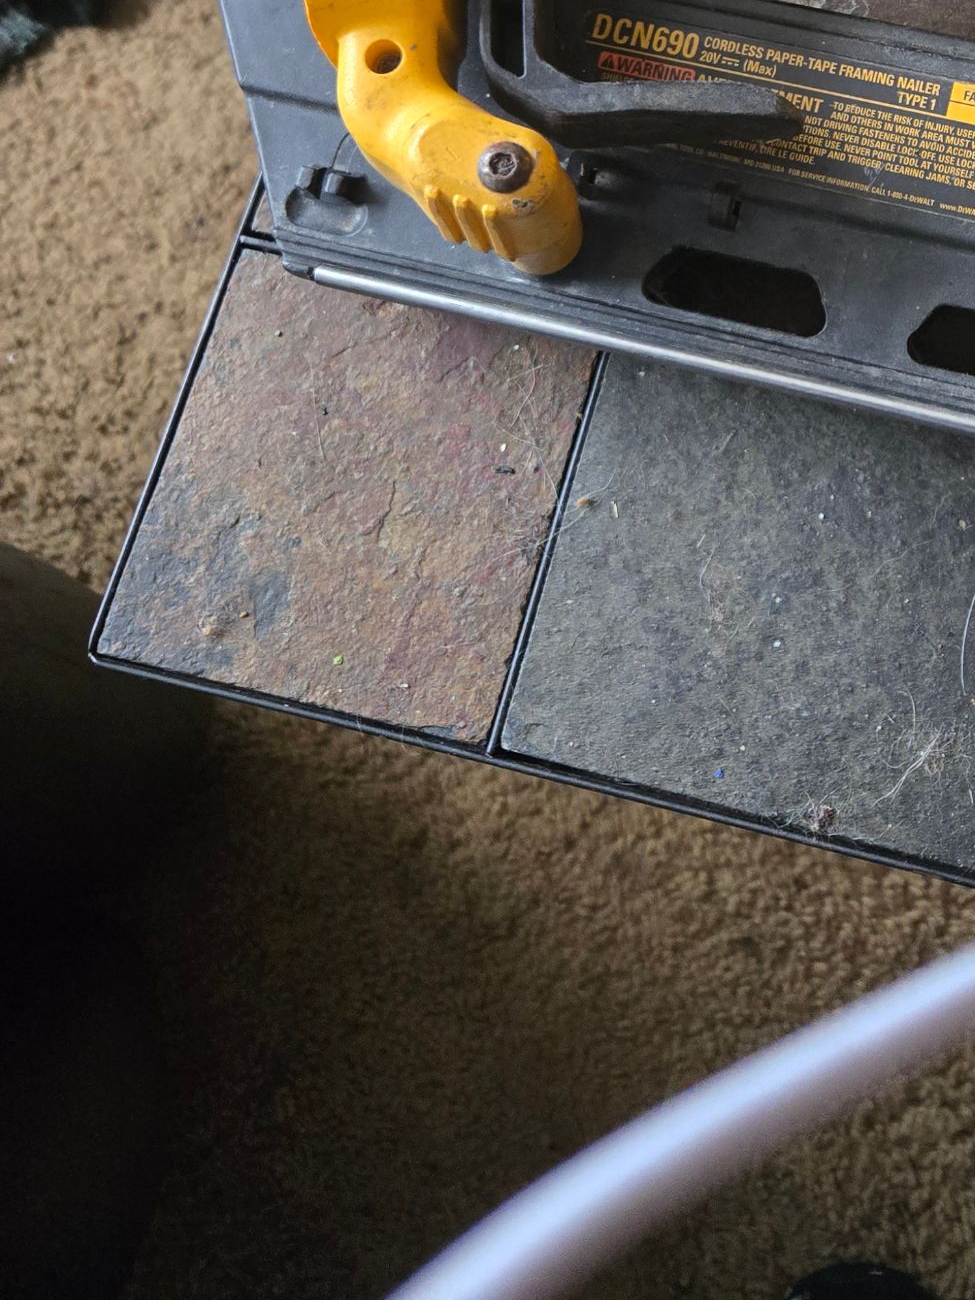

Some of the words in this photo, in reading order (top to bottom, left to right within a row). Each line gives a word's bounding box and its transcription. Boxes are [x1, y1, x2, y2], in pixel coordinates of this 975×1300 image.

[591, 14, 701, 59] DCN690
[703, 36, 764, 59] CORDLESS
[766, 48, 838, 75] PAPER-TAPE
[839, 64, 895, 87] FRAMING
[897, 76, 941, 96] NAILER
[743, 59, 777, 77] (Max)
[844, 104, 876, 118] REDUCE
[876, 111, 892, 121] THE
[893, 114, 912, 125] RISK
[913, 119, 924, 128] OF
[897, 92, 928, 109] TYPE
[929, 99, 937, 110] 1
[805, 115, 823, 126] NOT
[823, 119, 858, 133] DRIVING
[906, 137, 918, 147] TO
[919, 140, 945, 152] AVOID
[830, 111, 849, 122] AND
[850, 115, 883, 129] OTHERS
[884, 122, 893, 131] IN
[894, 125, 920, 137] WORK
[921, 130, 944, 142] AREA
[945, 136, 970, 148] MUST
[788, 152, 817, 165] GUIDE.
[832, 131, 860, 144] NEVER
[861, 138, 896, 152] DISABLE
[938, 154, 955, 165] USE
[843, 144, 871, 157] NEVER
[872, 150, 897, 162] POINT
[898, 156, 920, 167] TOOL
[920, 161, 932, 170] AT
[932, 163, 974, 179] YOURSELF
[801, 171, 826, 182] SERVICE
[871, 187, 887, 196] CALL
[808, 146, 827, 157] TRIP
[827, 150, 846, 161] AND
[884, 163, 925, 178] CLEARING
[953, 177, 966, 187] OR
